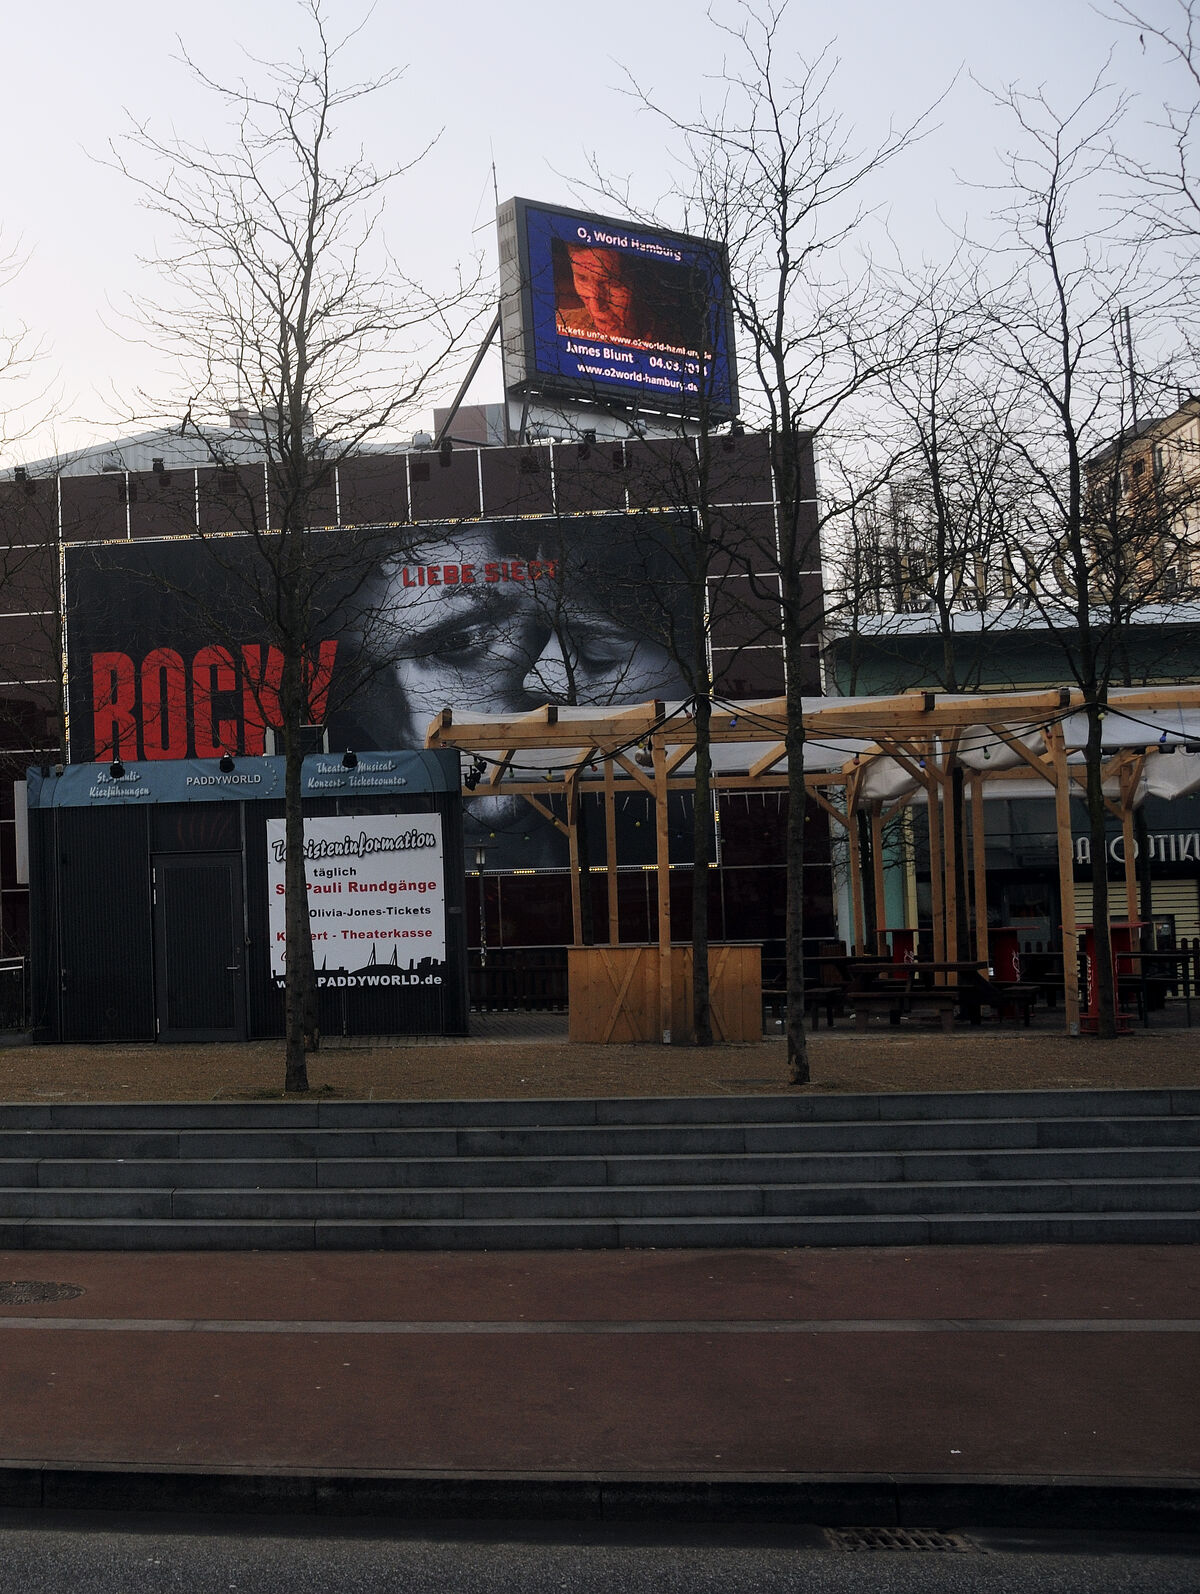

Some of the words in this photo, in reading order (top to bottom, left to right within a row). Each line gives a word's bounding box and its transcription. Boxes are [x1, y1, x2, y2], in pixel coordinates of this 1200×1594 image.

[594, 230, 628, 248] World
[566, 341, 601, 358] James
[603, 347, 634, 364] Blunt
[402, 564, 476, 588] LIEBE
[484, 559, 559, 583] SIEGT
[357, 760, 397, 773] Musical-
[186, 774, 261, 785] PADDYWORLD
[308, 777, 346, 788] Konzert-
[349, 776, 408, 787] Ticketcounter
[89, 786, 150, 798] Kiezführungen
[313, 867, 357, 878] täglich
[348, 880, 437, 894] Rundgänge
[309, 906, 431, 918] Olivia-Jones-Tickets
[341, 929, 433, 940] Theaterkasse
